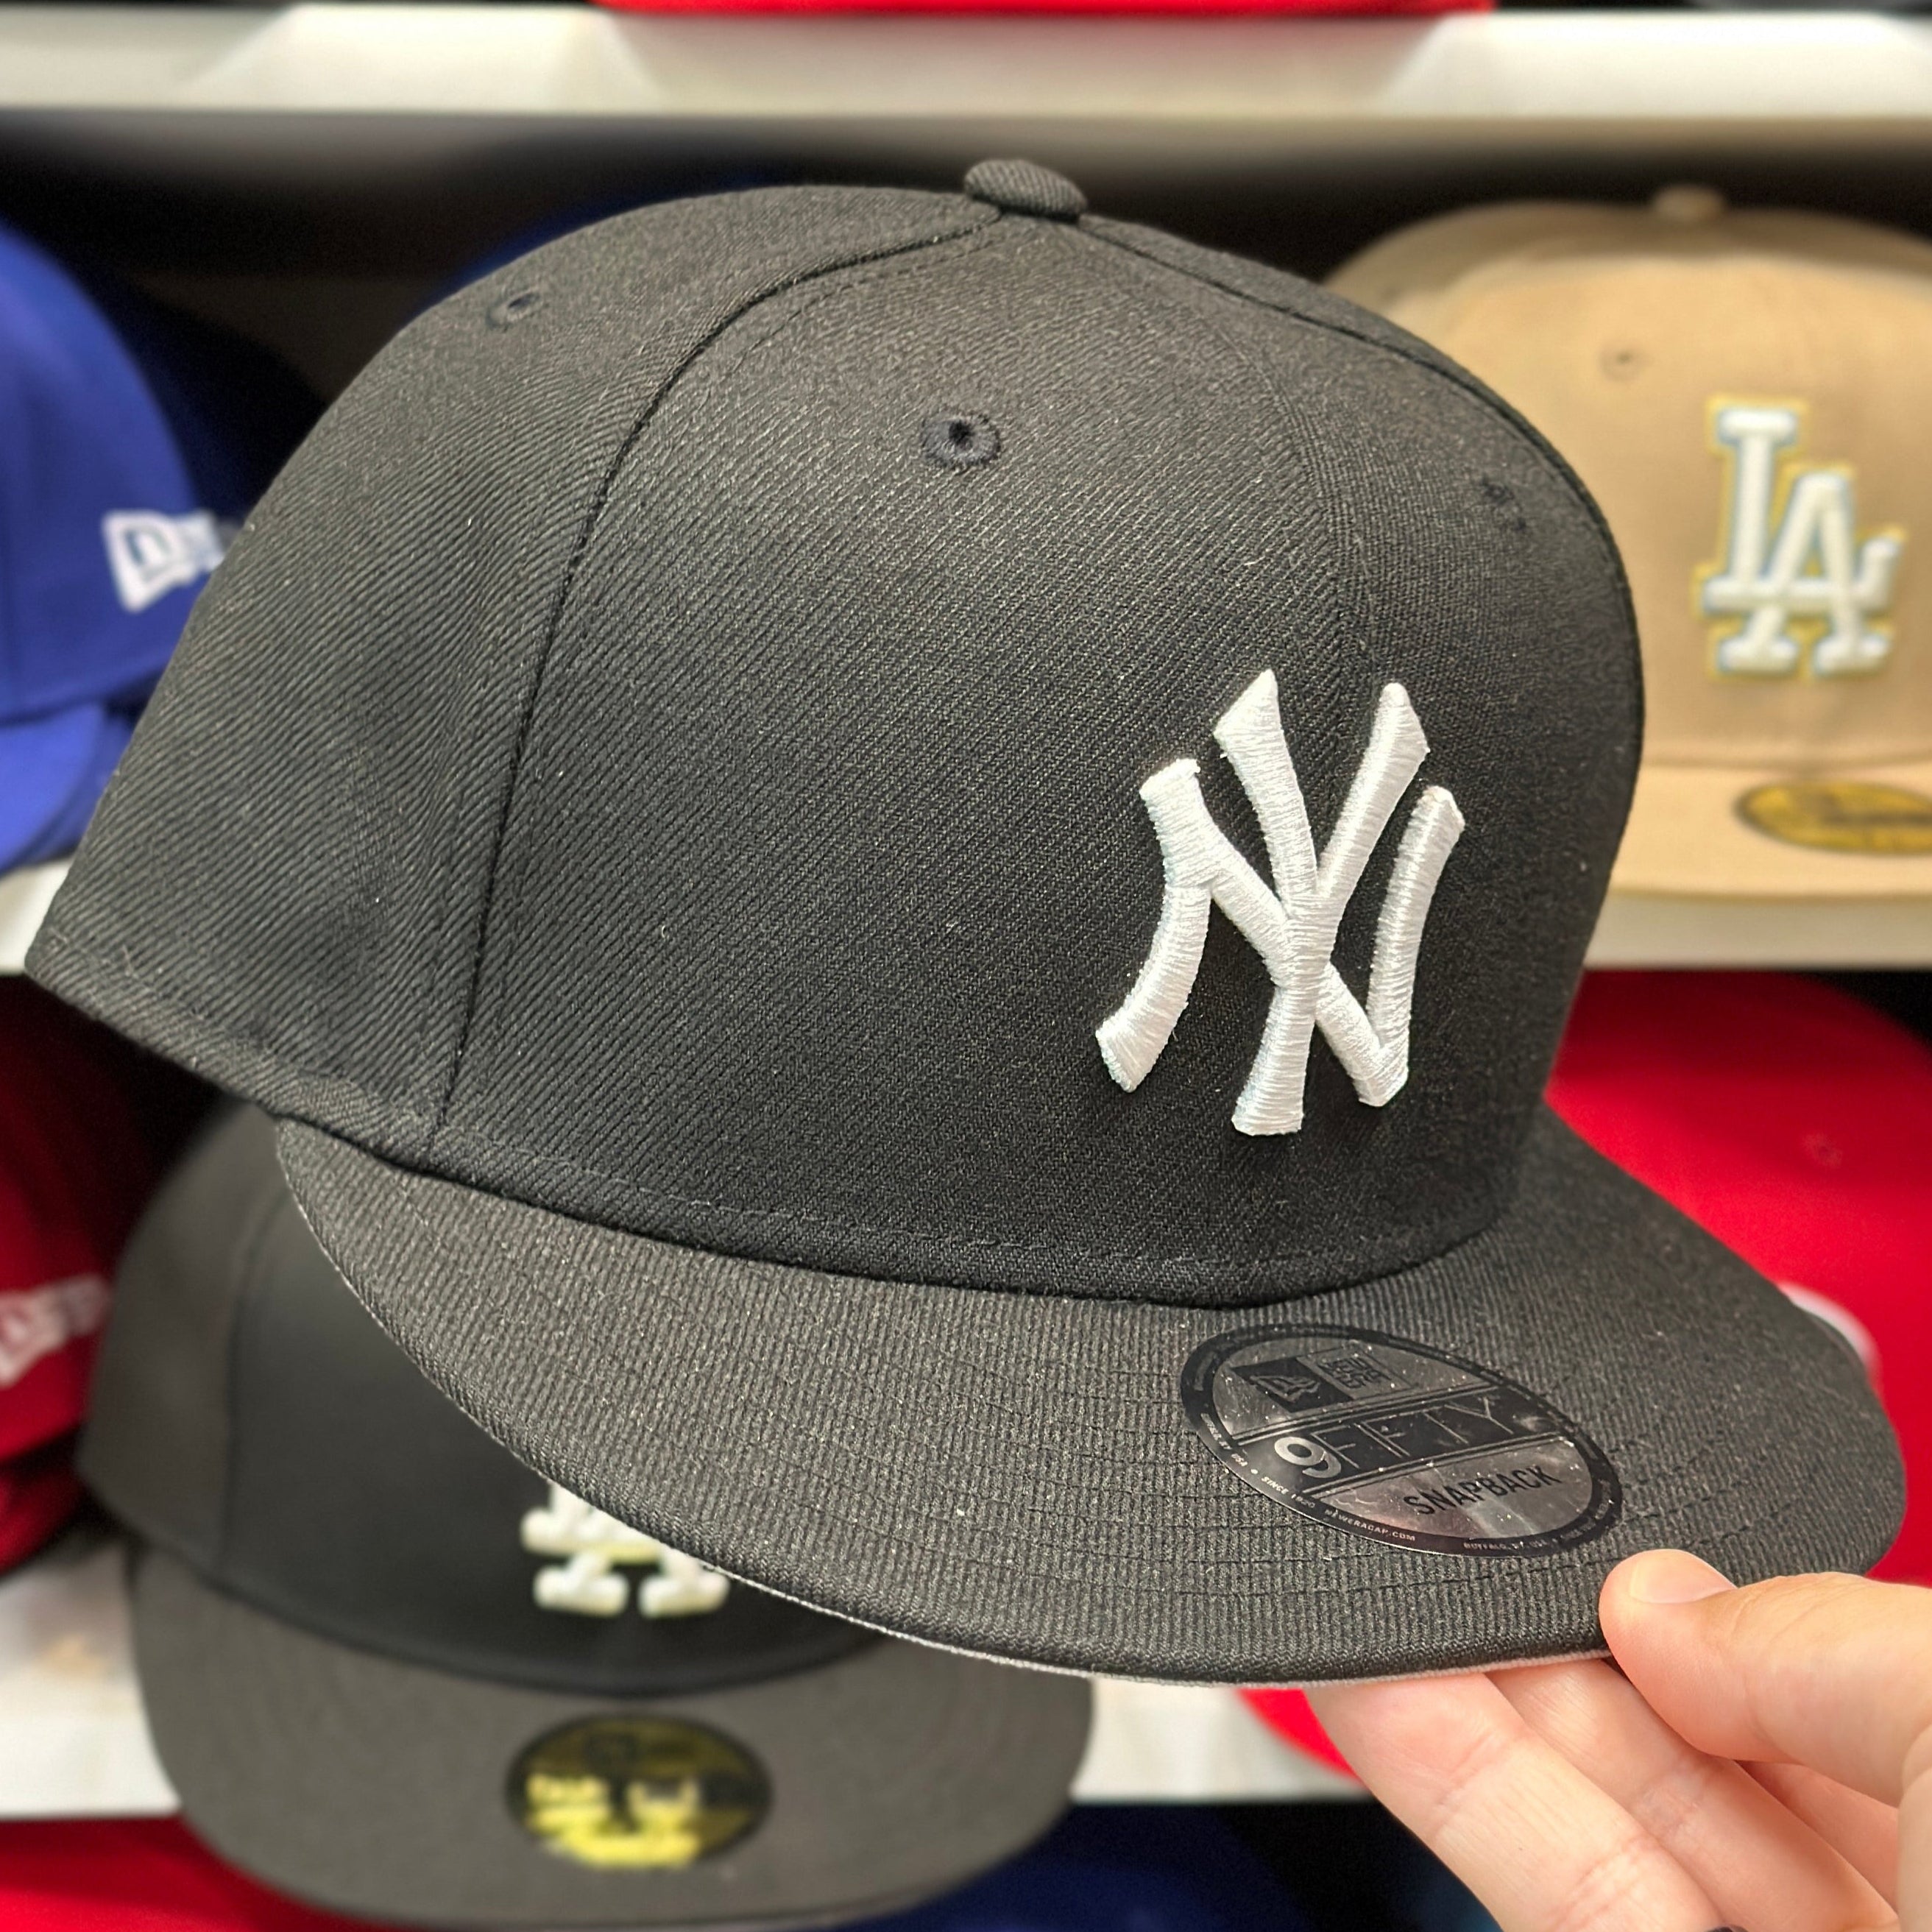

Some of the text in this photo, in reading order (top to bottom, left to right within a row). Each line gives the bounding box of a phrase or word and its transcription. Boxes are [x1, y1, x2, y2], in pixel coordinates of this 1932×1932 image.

[1696, 396, 1903, 677] LA
[1096, 669, 1465, 1136] NY
[1275, 1396, 1514, 1479] 9FIFTY
[1262, 1476, 1289, 1495] SINCE
[1403, 1465, 1562, 1514] SNAPBACK
